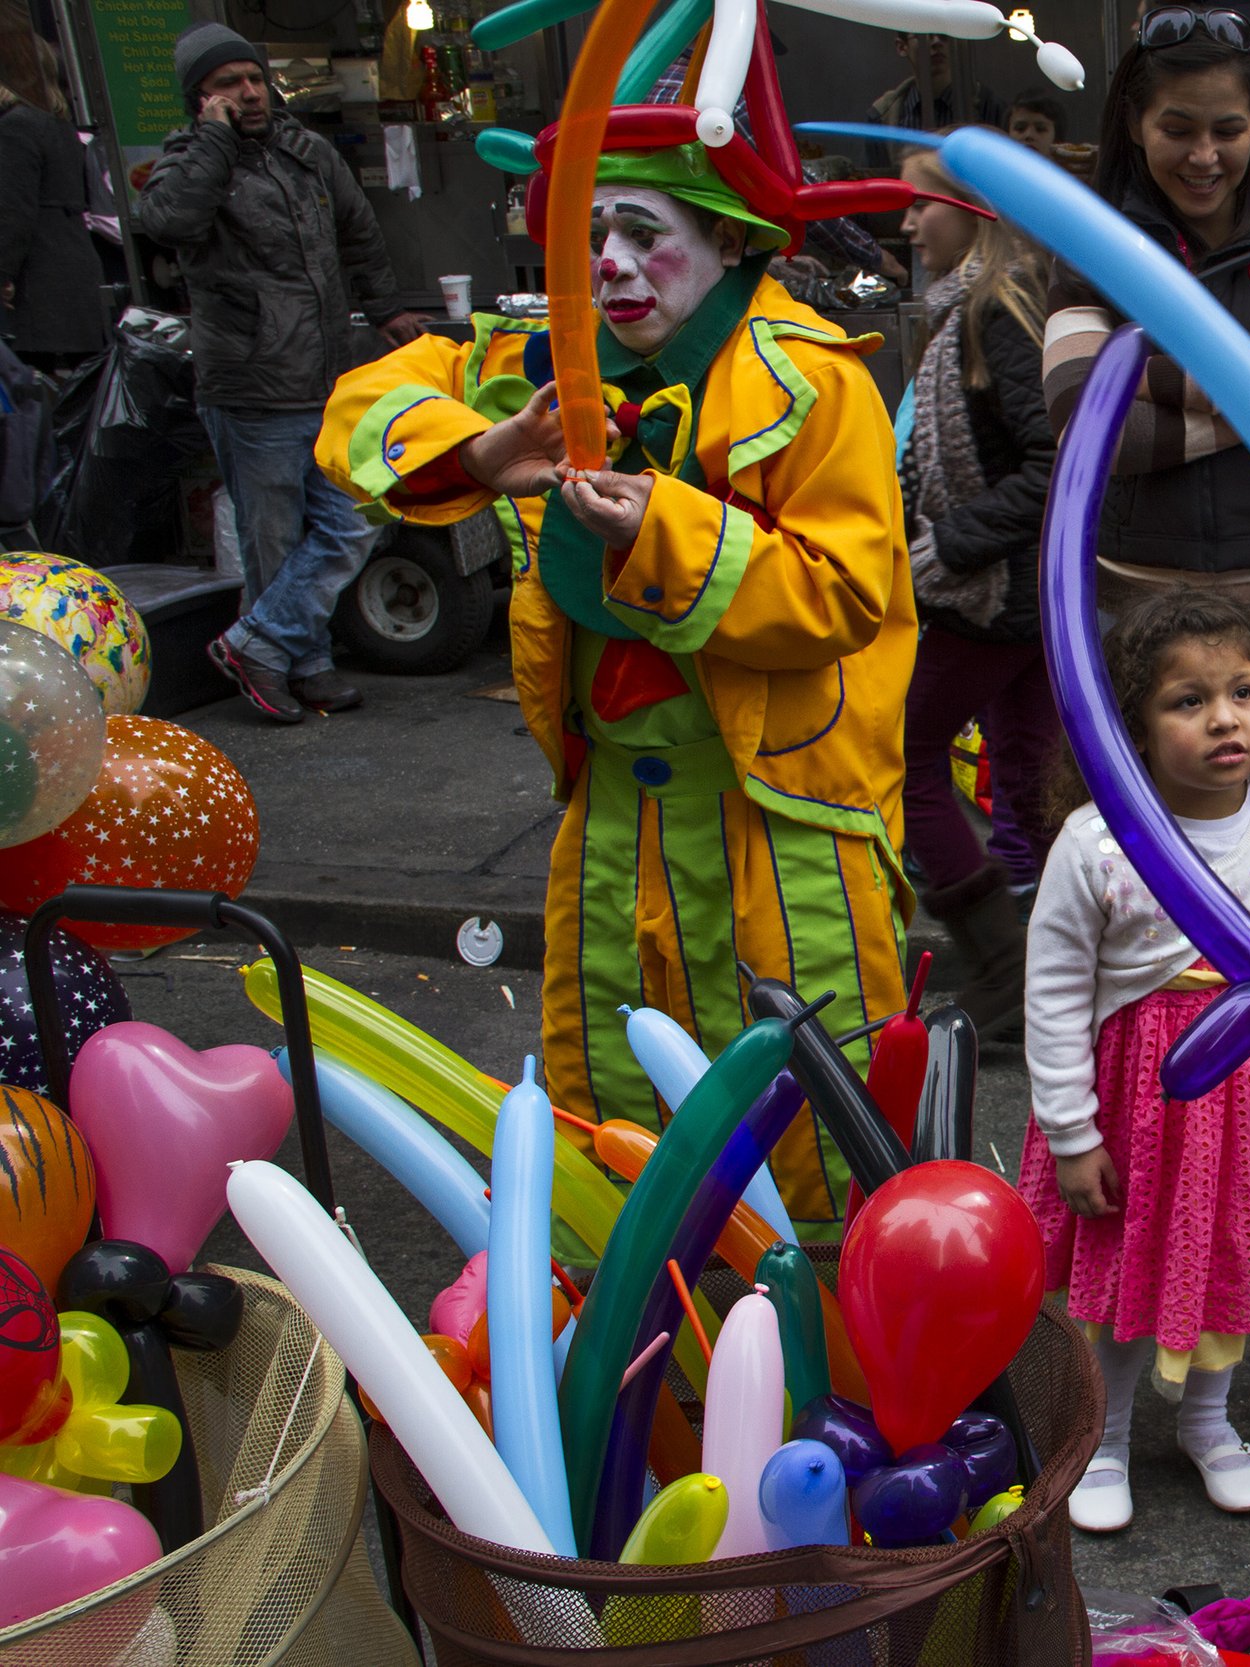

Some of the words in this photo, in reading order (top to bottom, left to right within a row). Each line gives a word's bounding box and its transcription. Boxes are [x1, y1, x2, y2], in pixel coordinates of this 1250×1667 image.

[95, 0, 144, 11] Chicken
[147, 0, 185, 11] Kebab
[117, 16, 138, 26] Hot
[140, 16, 166, 29] Dog
[108, 31, 129, 42] Hot
[122, 47, 150, 57] Chili
[123, 63, 144, 73] Hot
[147, 63, 177, 73] Knis
[140, 76, 170, 88] Soda
[142, 93, 174, 103] Water
